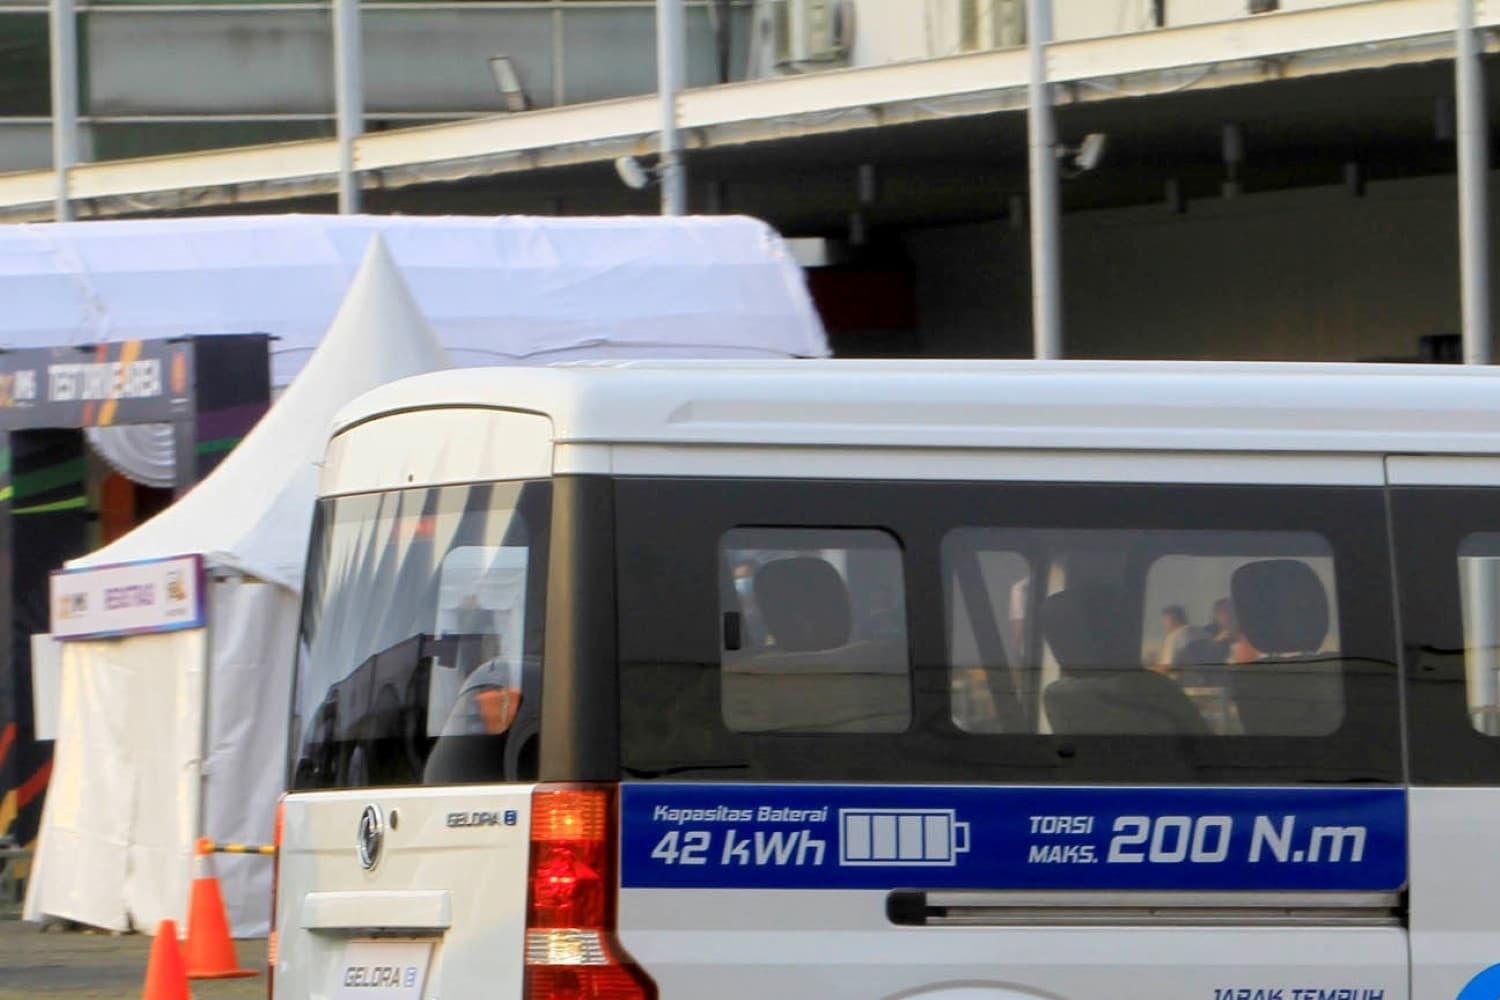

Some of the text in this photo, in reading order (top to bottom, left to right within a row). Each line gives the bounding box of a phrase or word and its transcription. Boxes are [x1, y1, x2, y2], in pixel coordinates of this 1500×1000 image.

[652, 805, 828, 825] Kapasitas Baterai
[1028, 815, 1094, 834] TORSI
[651, 829, 827, 866] 42 kWh
[1107, 815, 1367, 864] 200 N.m
[1027, 845, 1098, 864] MAKS.
[343, 966, 400, 988] GELORA
